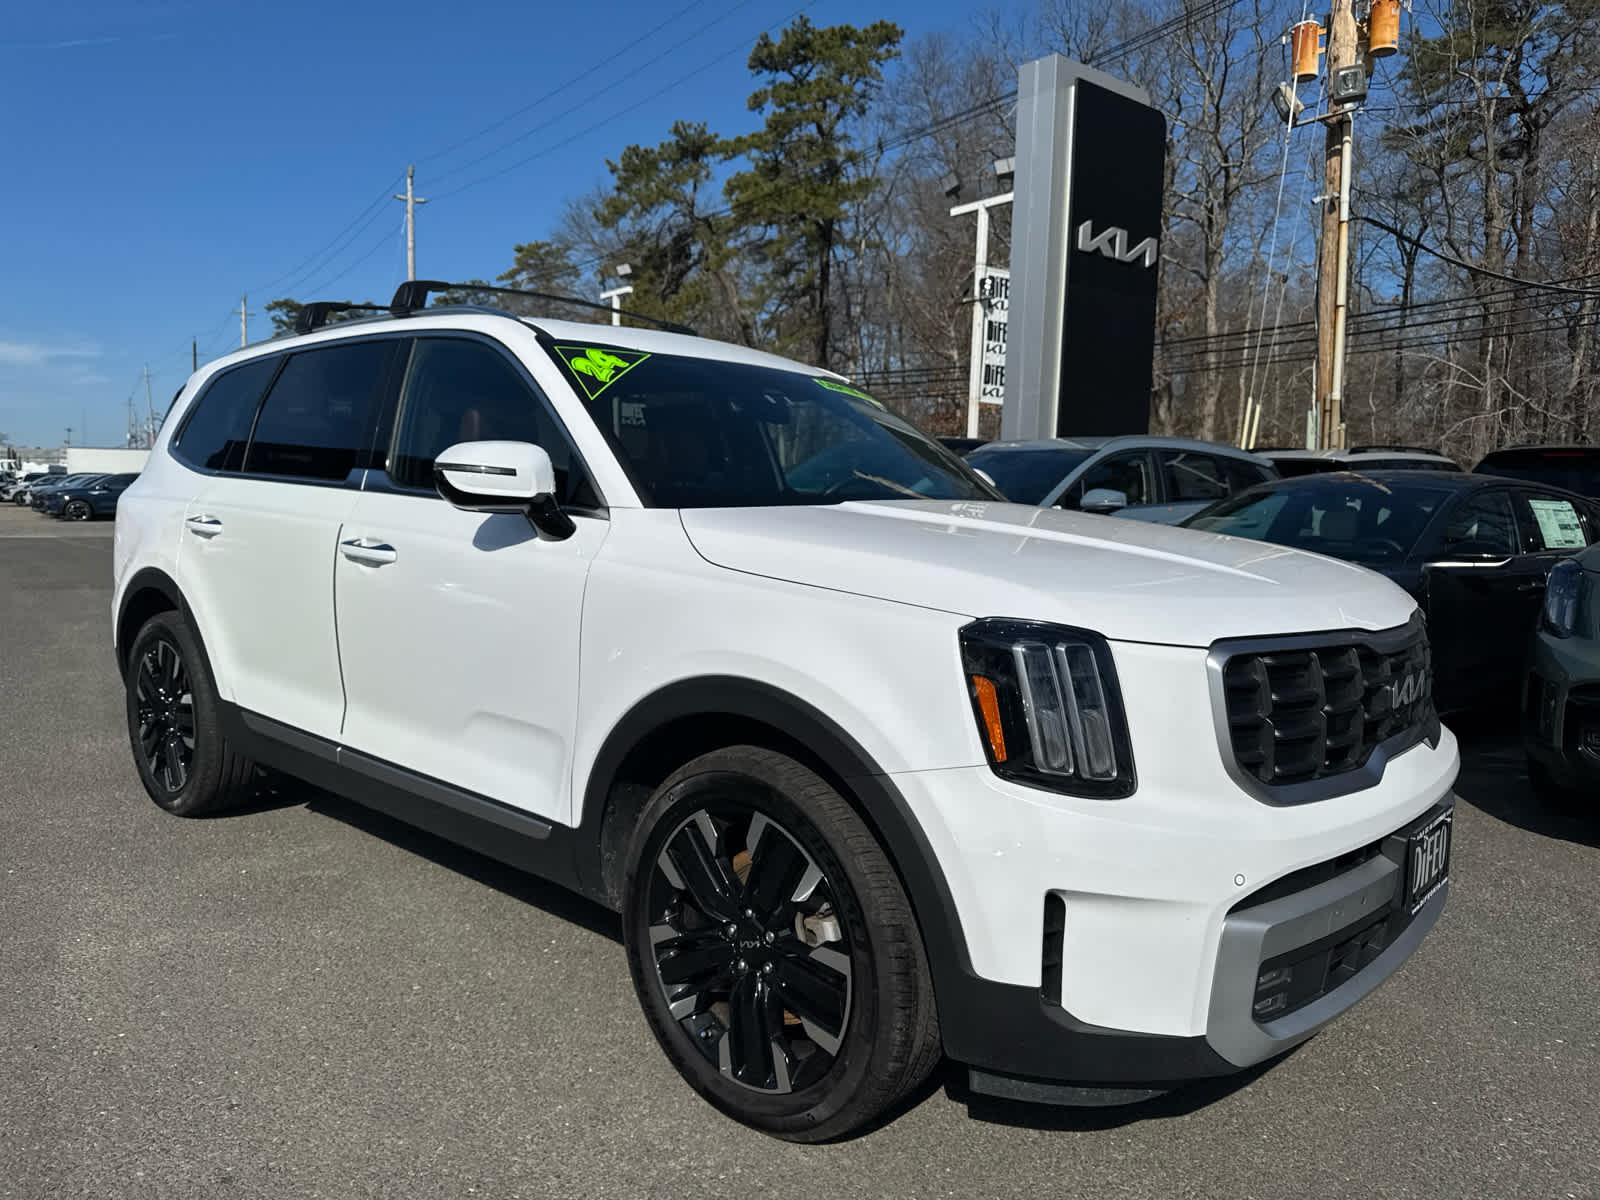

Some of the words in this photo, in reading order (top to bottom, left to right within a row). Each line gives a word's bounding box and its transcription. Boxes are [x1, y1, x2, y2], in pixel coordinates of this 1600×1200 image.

[1078, 219, 1158, 268] KIA
[570, 348, 630, 383] 24
[986, 343, 1007, 355] KI
[982, 387, 1005, 398] KI
[1391, 669, 1425, 709] KIA
